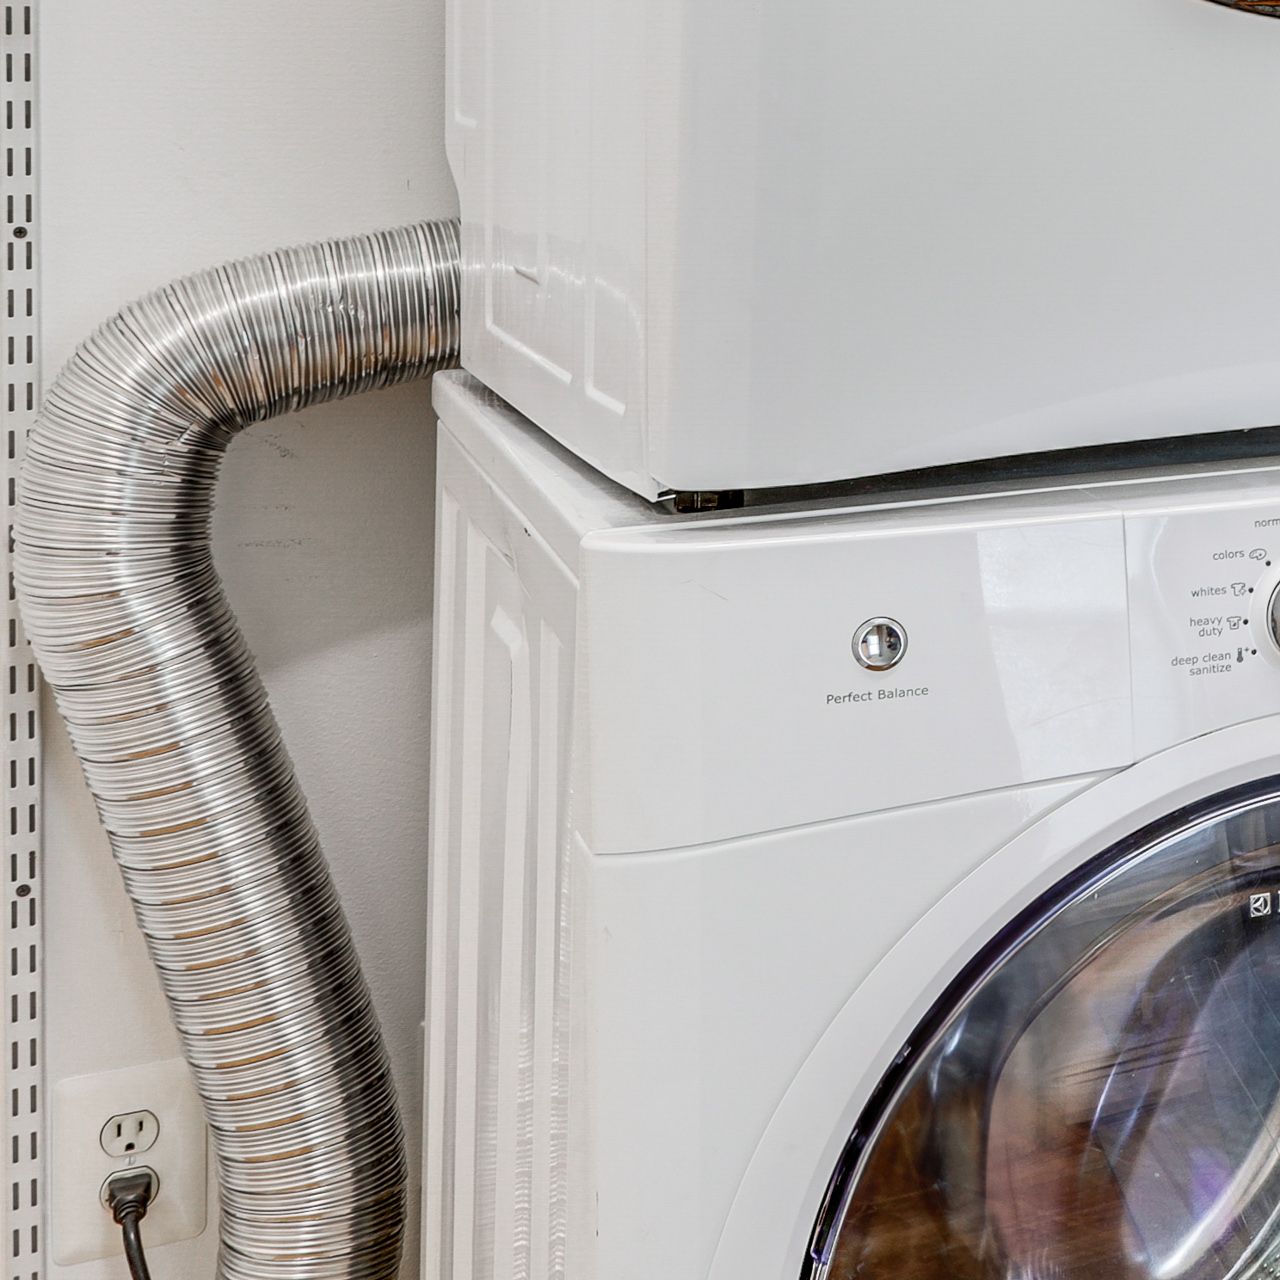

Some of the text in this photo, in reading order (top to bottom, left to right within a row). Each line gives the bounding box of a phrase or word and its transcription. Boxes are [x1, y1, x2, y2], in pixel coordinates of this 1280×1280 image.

[1213, 550, 1244, 561] colors
[1191, 585, 1226, 598] whites
[1189, 616, 1223, 628] heavy
[1199, 626, 1223, 638] duty
[1171, 651, 1231, 667] deep clean
[1189, 663, 1232, 676] sanitize
[827, 687, 928, 704] Perfect Balance
